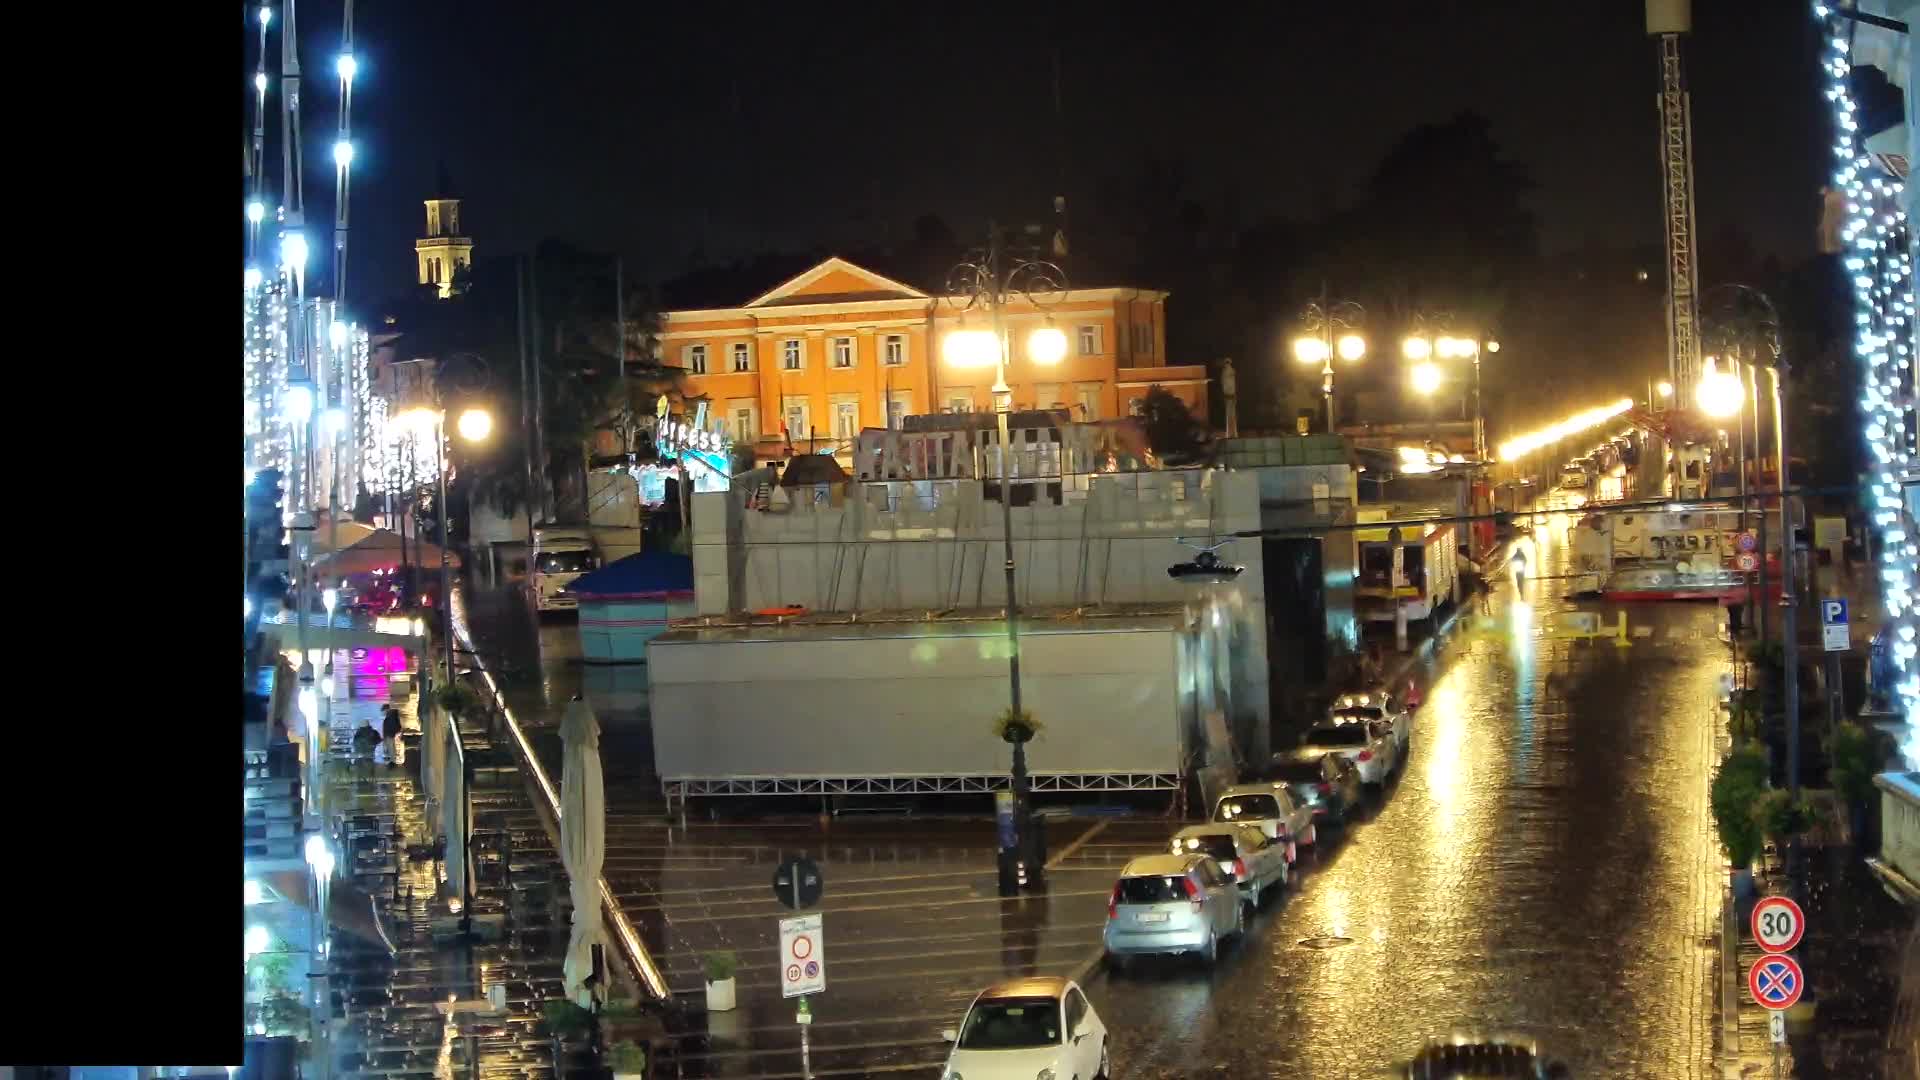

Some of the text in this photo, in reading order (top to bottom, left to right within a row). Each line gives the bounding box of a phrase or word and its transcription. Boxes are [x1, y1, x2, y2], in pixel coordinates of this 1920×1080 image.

[1826, 602, 1842, 622] P
[1763, 912, 1791, 937] 30
[790, 969, 799, 978] 10
